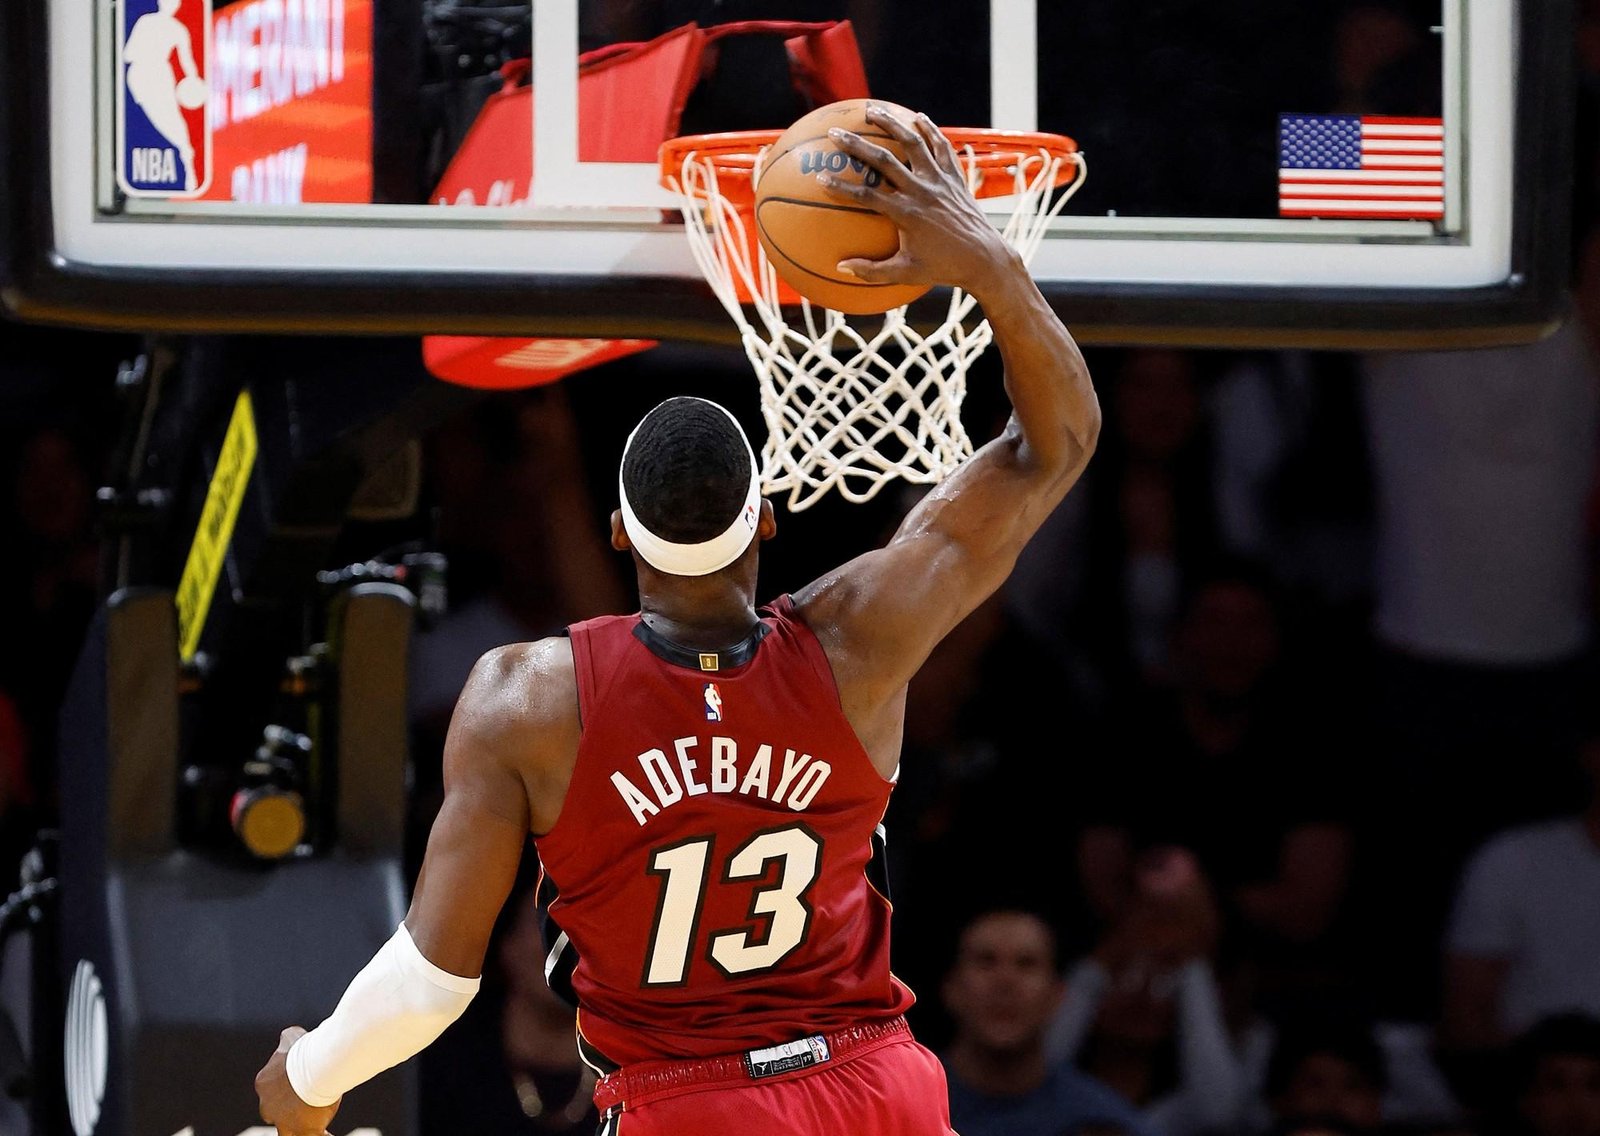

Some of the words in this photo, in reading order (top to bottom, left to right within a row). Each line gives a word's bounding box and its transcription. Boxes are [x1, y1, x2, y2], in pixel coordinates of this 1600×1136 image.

[132, 147, 177, 183] NBA
[610, 736, 831, 826] ADEBAYO
[643, 822, 822, 986] 13
